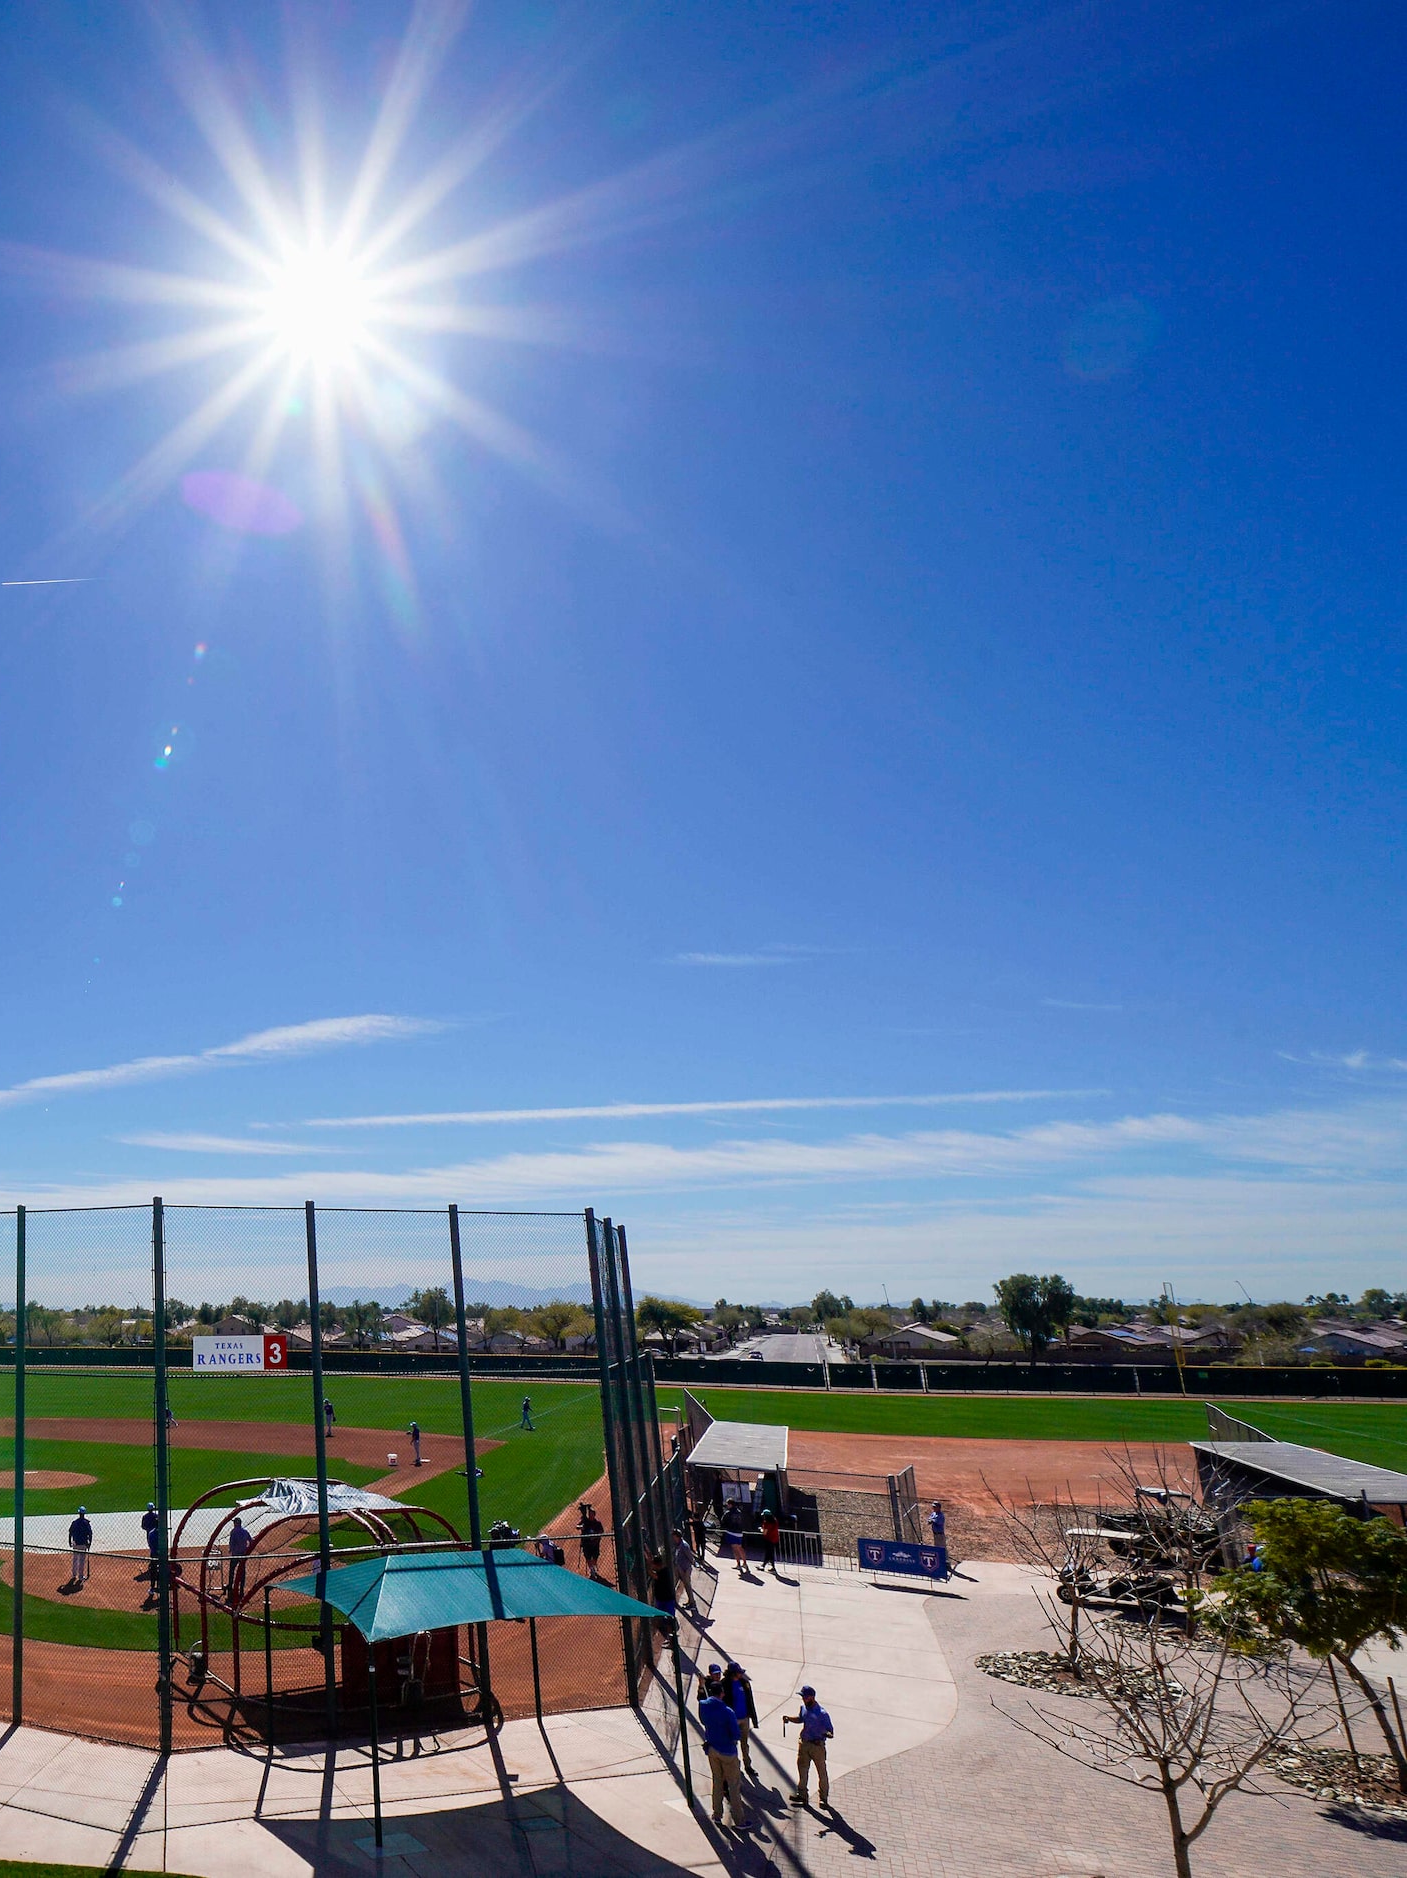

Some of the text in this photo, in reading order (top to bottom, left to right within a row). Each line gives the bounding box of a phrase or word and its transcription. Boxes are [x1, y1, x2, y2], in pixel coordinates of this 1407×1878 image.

[197, 1353, 261, 1365] RANGERS
[269, 1343, 282, 1364] 3
[869, 1550, 880, 1561] T
[923, 1556, 934, 1567] T
